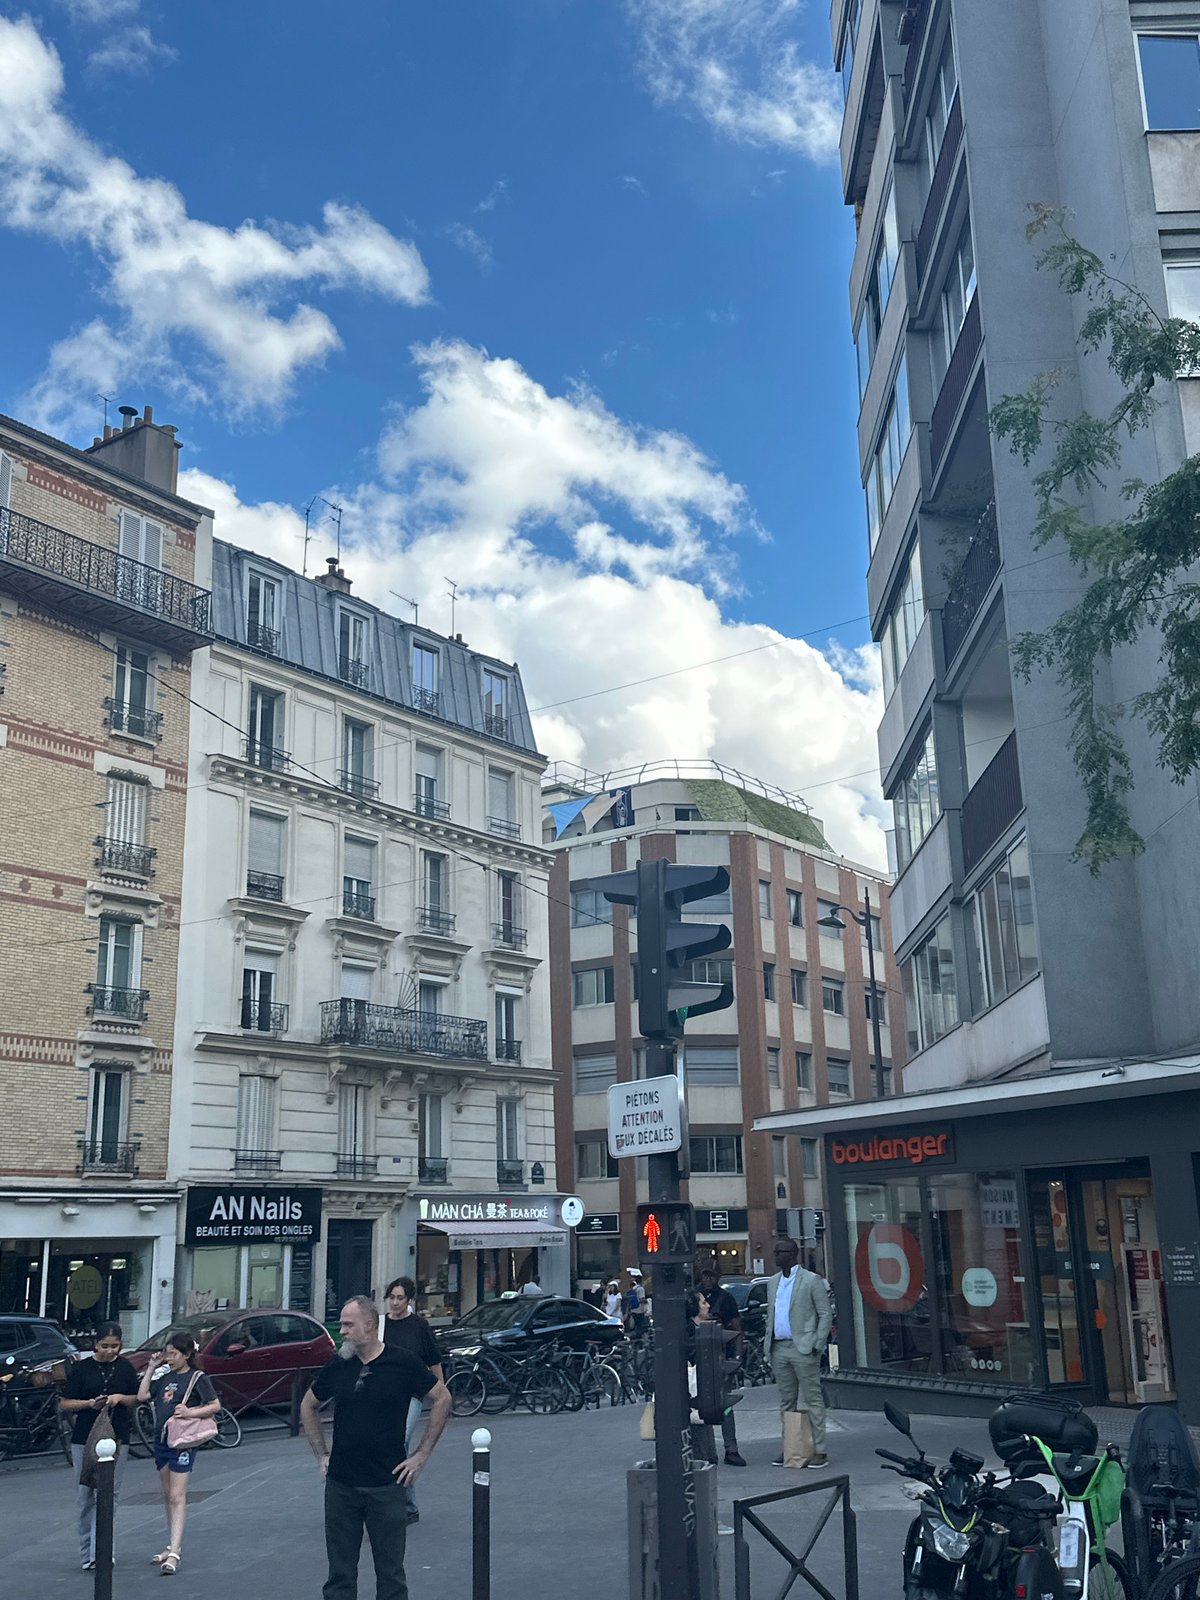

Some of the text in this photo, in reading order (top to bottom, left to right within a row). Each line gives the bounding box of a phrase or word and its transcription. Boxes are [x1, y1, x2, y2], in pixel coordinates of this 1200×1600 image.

[626, 1091, 660, 1107] PIÉTONS
[622, 1110, 664, 1127] ATTENTION
[638, 1126, 674, 1145] DÉCALÉS
[832, 1134, 947, 1164] boulanger
[209, 1196, 303, 1220] AN Nails
[431, 1202, 459, 1219] MÀN
[460, 1202, 484, 1219] CHÁ
[196, 1224, 313, 1237] BEAUTÉ ET SOIN DES ONGLES
